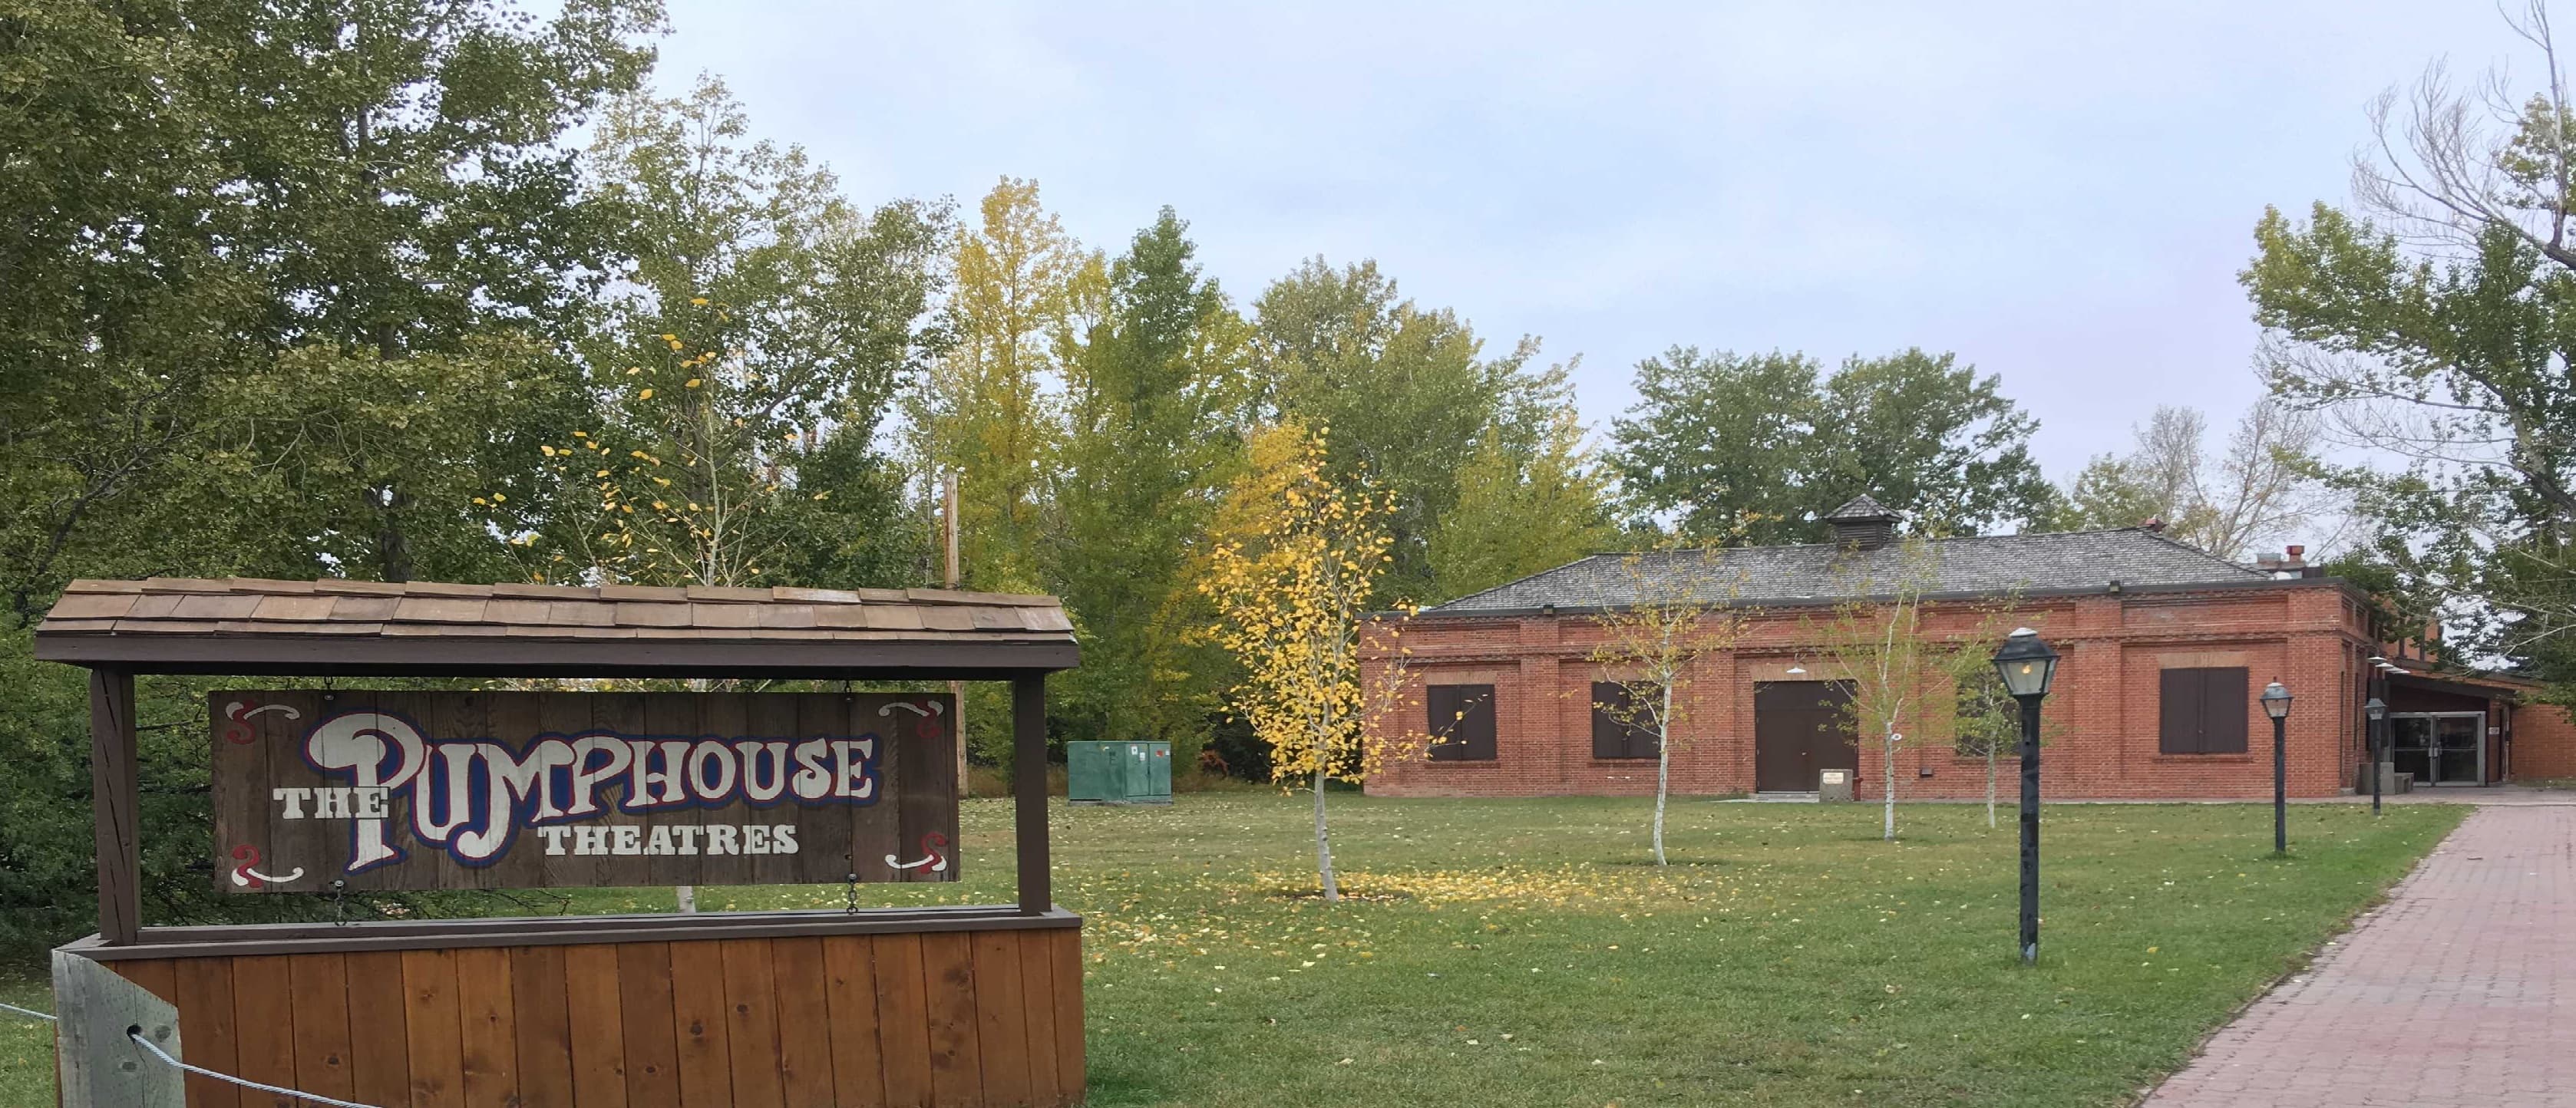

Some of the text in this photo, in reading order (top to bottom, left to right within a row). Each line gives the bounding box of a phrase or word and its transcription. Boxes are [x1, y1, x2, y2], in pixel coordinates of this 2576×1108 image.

[272, 712, 874, 872] THE PUMPHOUSE
[537, 824, 799, 856] THEATRES
